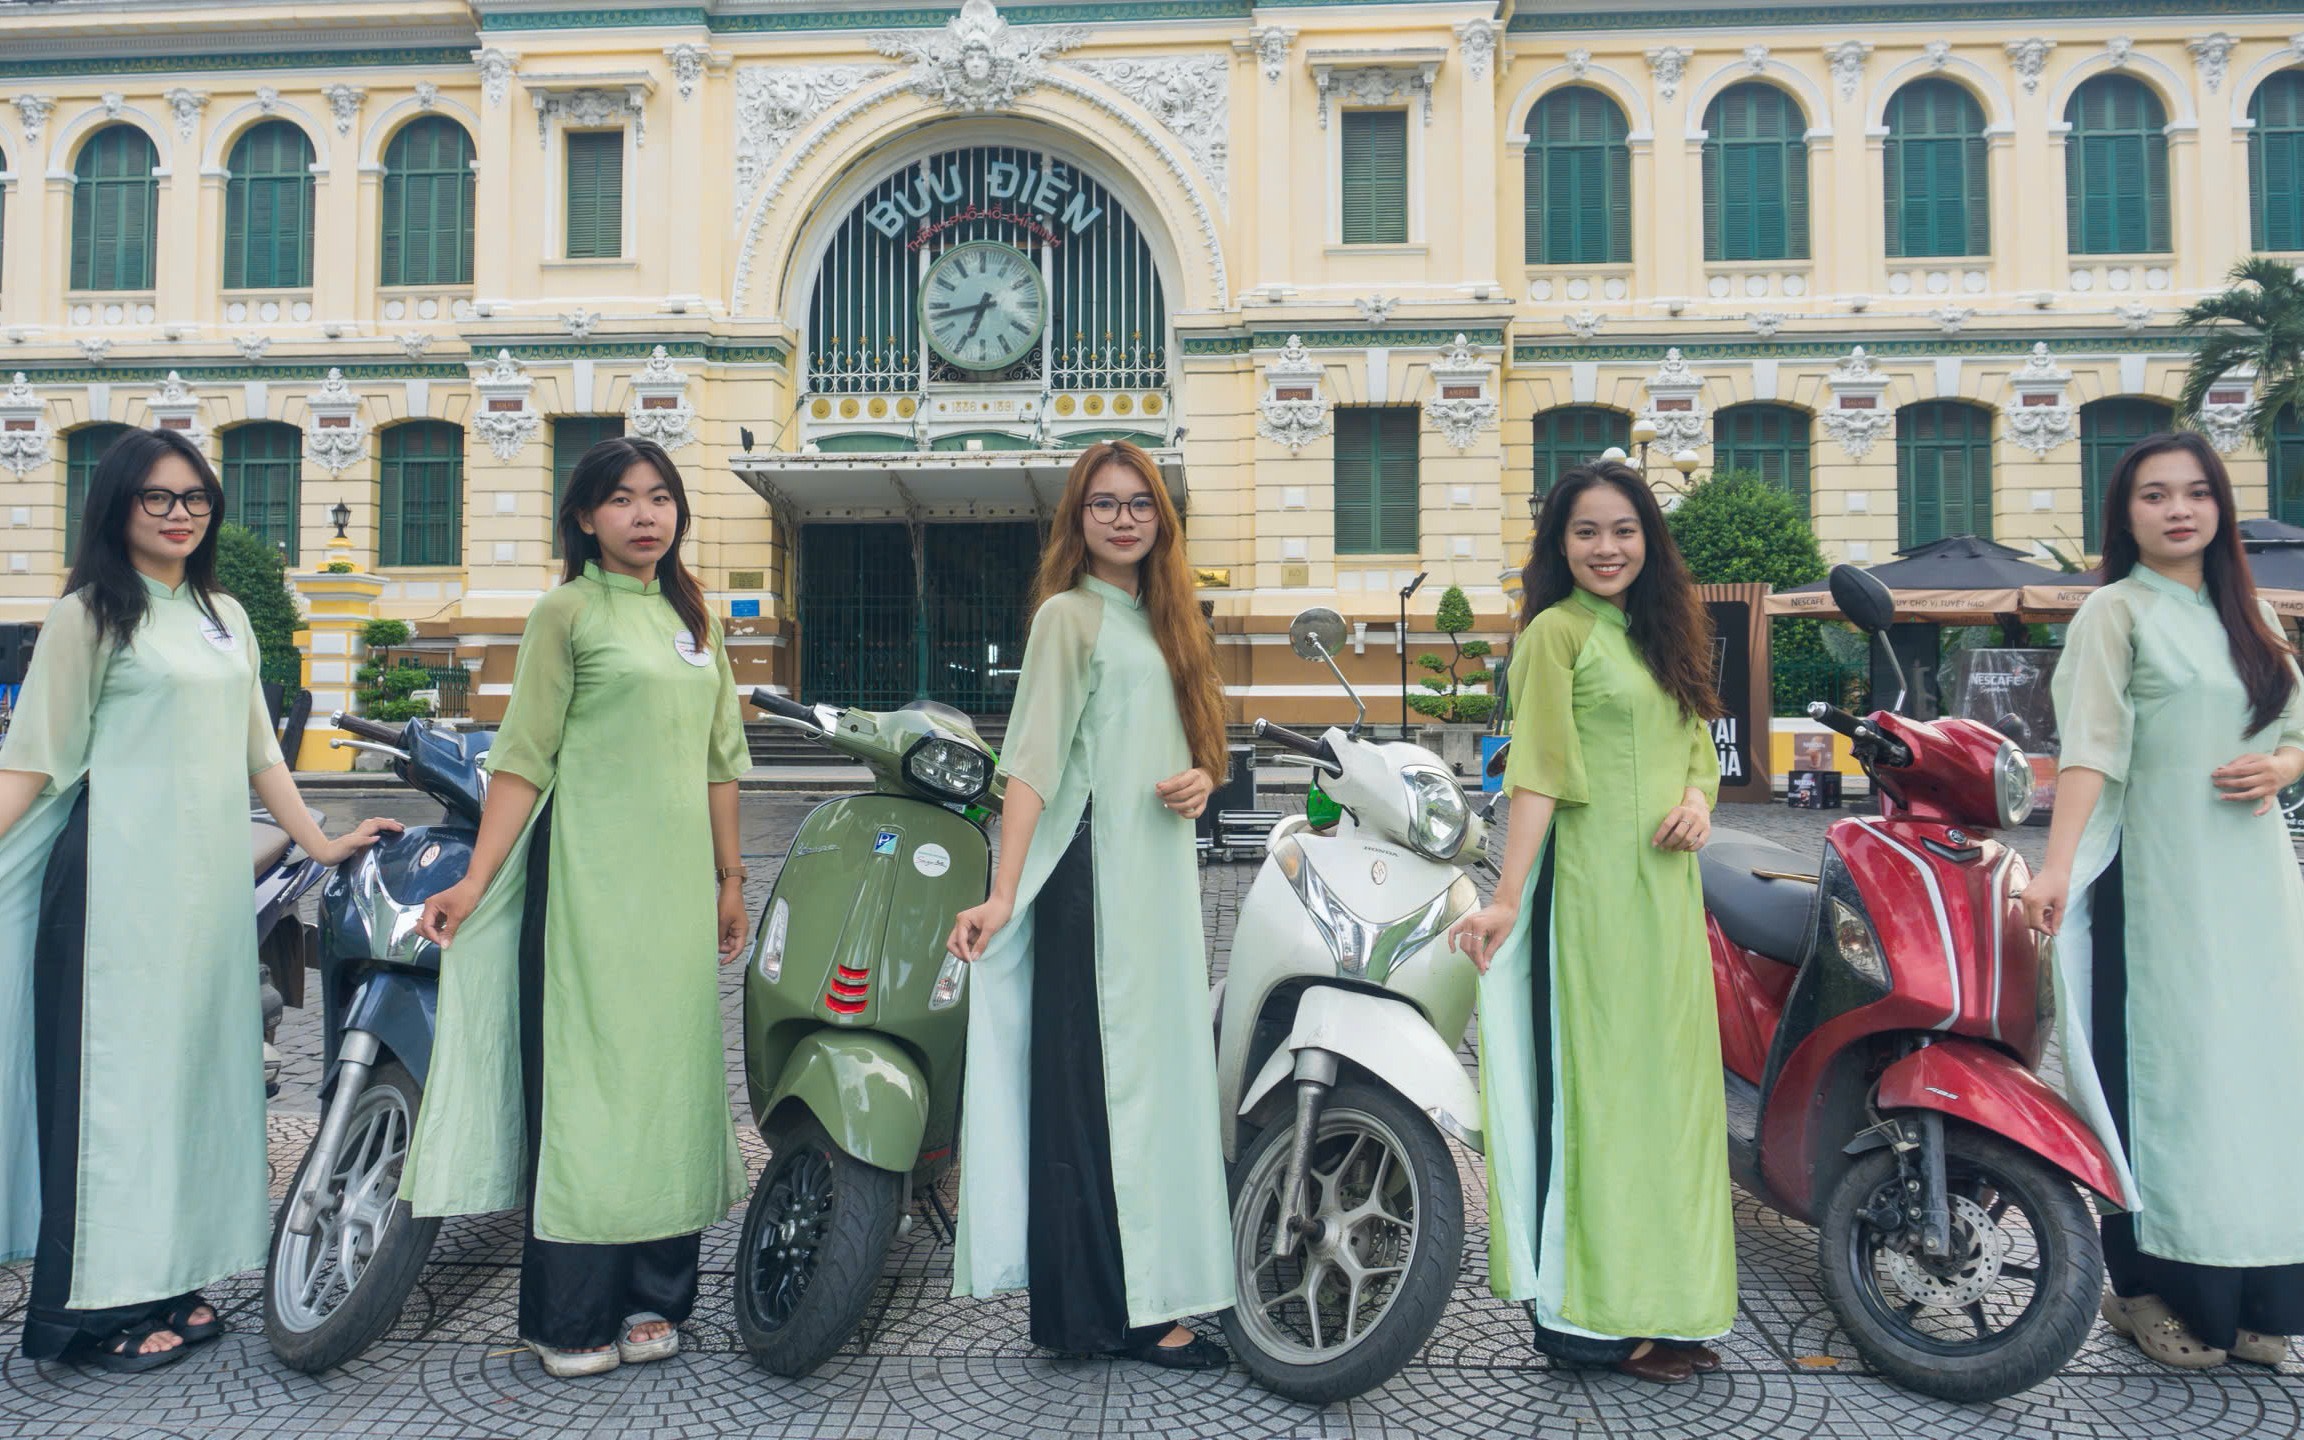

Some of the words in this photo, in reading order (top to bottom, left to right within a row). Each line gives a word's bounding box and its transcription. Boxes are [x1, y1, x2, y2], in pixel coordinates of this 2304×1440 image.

[986, 161, 1103, 236] ĐIỆN
[949, 202, 978, 225] PHỐ
[982, 202, 1002, 220] HỒ
[1030, 222, 1062, 248] MINH
[1714, 718, 1737, 748] ẠI
[1363, 846, 1399, 857] HONDA
